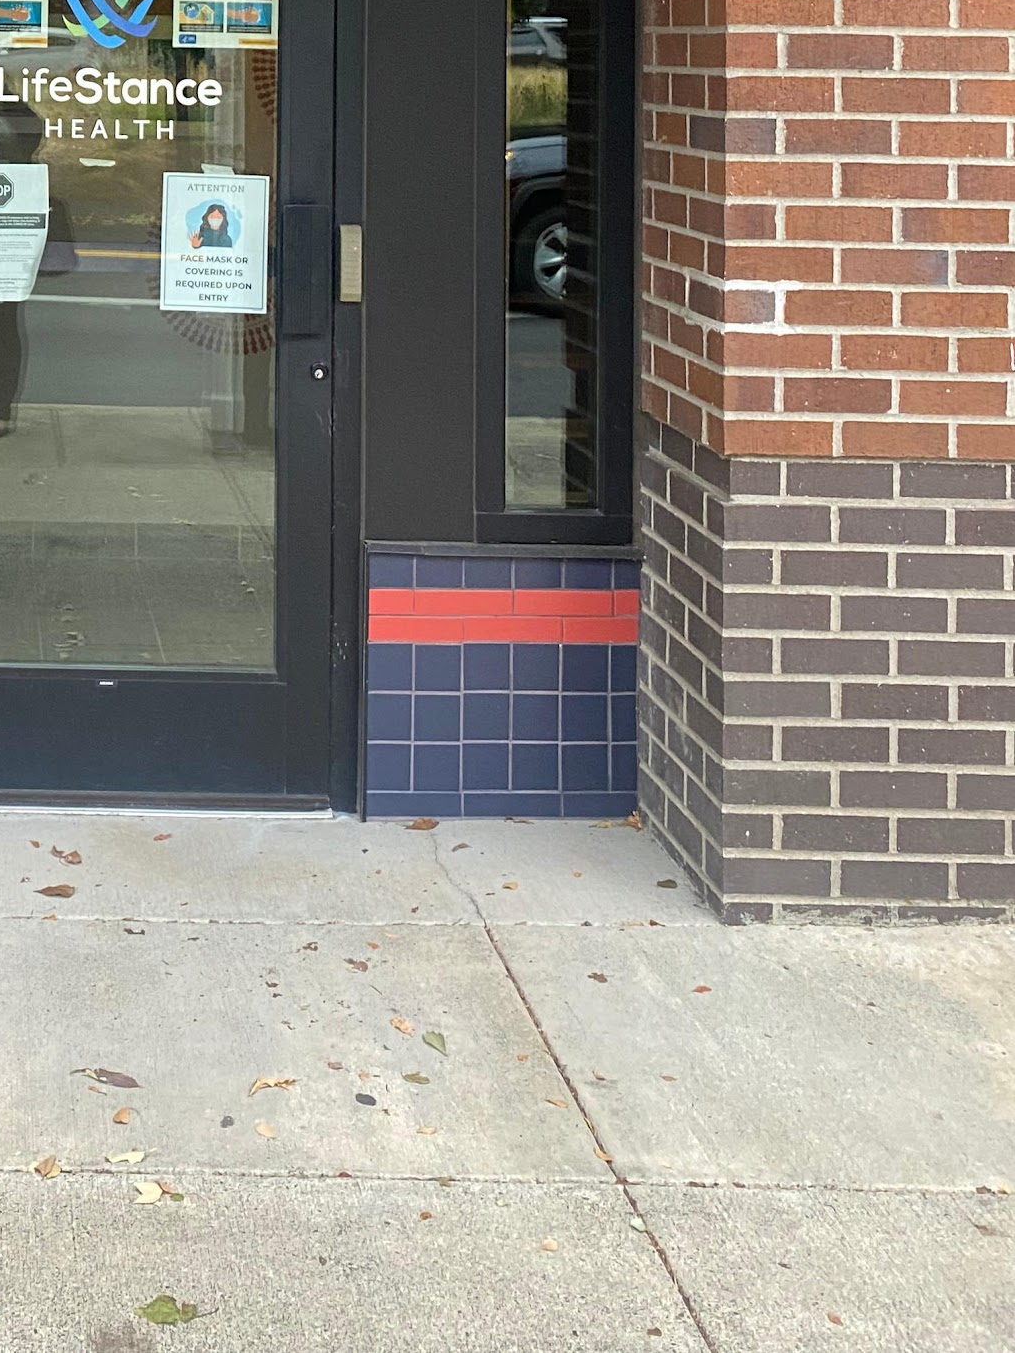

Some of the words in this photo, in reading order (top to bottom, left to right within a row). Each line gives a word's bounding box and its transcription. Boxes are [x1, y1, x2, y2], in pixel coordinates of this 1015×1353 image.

[45, 118, 174, 140] HEALTH
[187, 183, 245, 193] ATTENTION
[180, 254, 204, 263] FACE
[206, 255, 233, 264] MASK
[185, 267, 233, 277] COVERING
[234, 269, 243, 277] IS
[175, 280, 223, 289] REQUIRED
[225, 282, 252, 290] UPON
[198, 293, 229, 302] ENTRY
